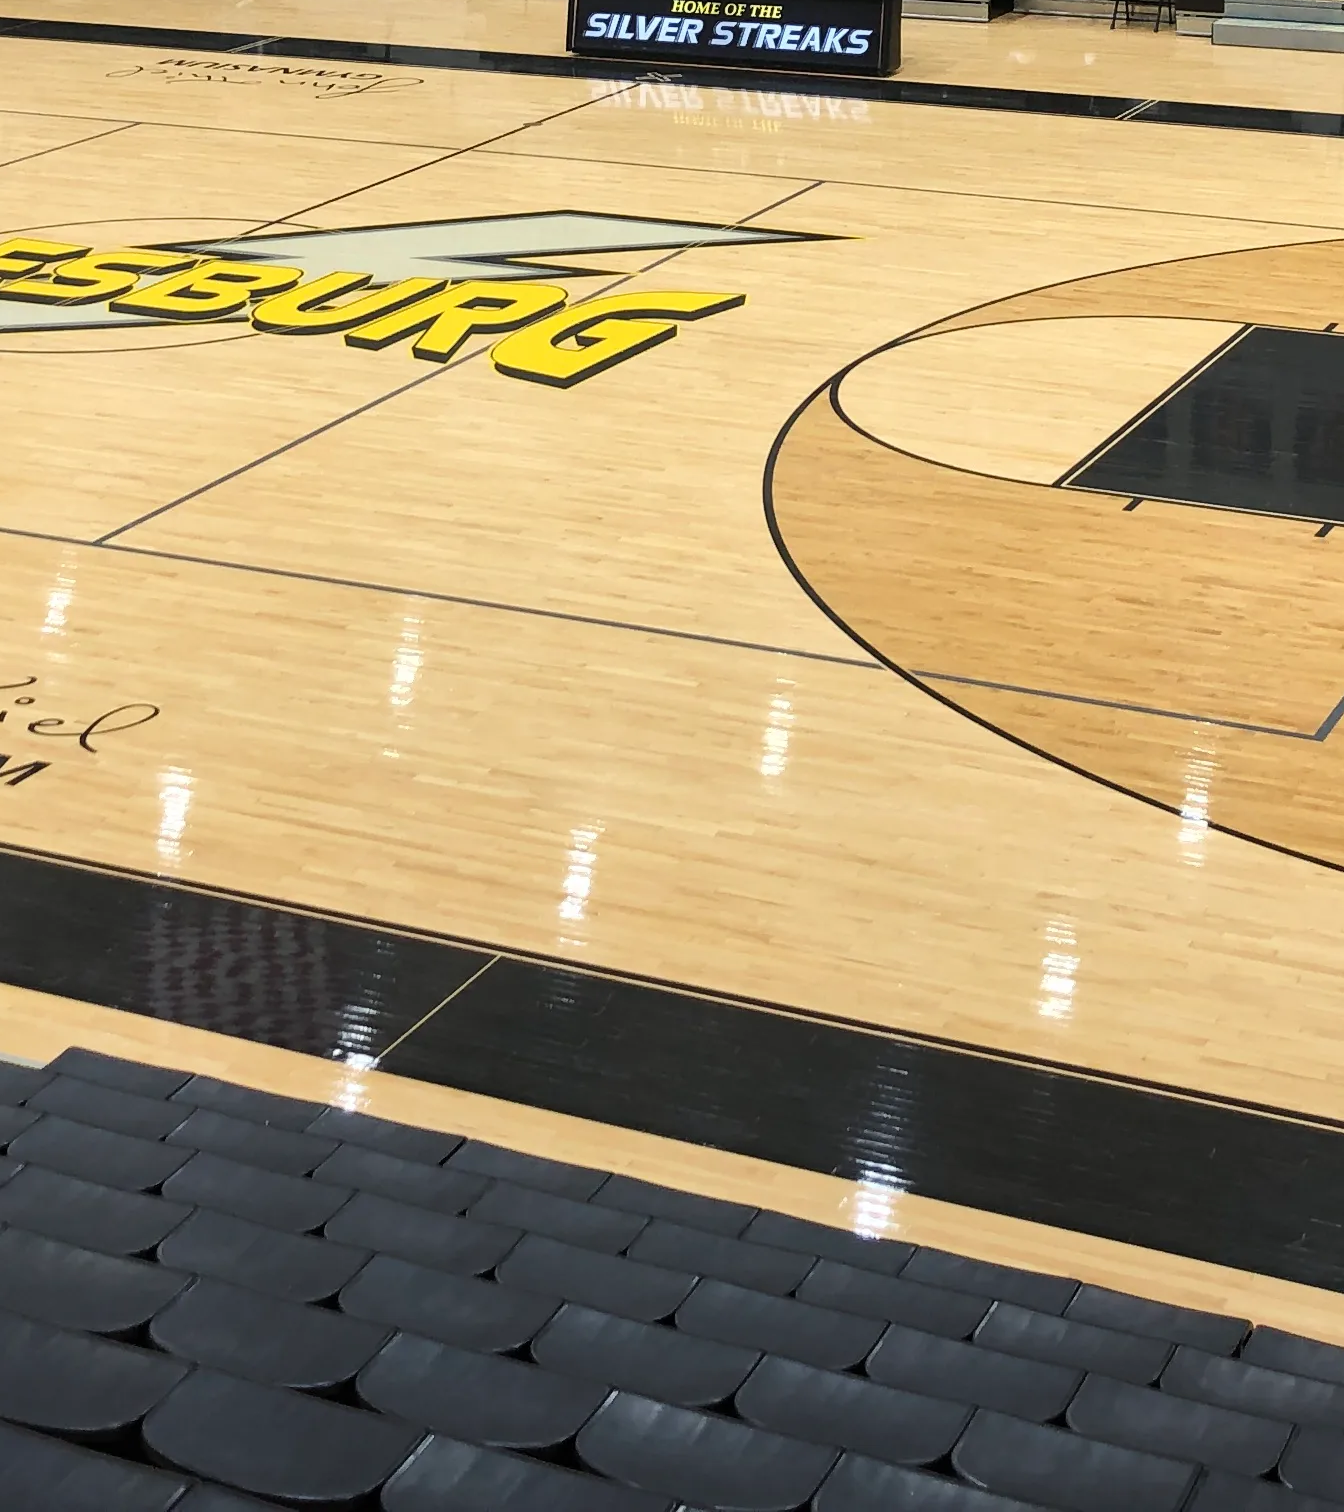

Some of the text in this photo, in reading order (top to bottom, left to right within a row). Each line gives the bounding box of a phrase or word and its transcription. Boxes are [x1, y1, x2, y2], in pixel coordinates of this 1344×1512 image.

[671, 0, 783, 19] HOME OF THE
[583, 13, 873, 55] SILVER STREAKS
[158, 58, 383, 80] GYMNASIUM
